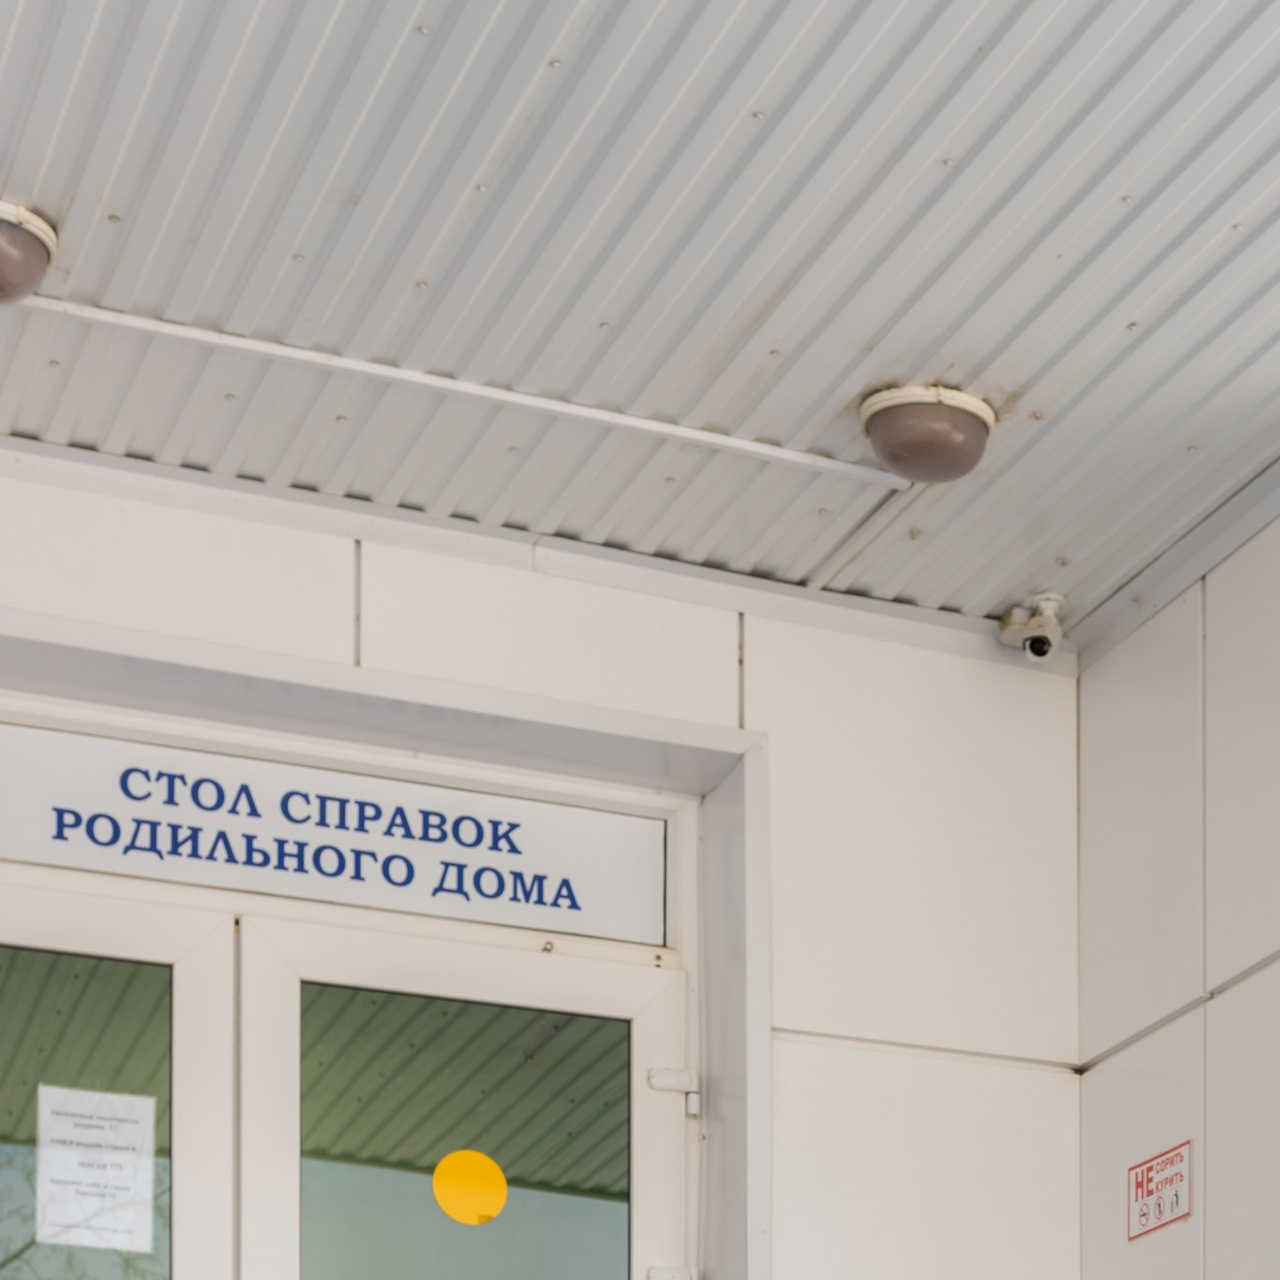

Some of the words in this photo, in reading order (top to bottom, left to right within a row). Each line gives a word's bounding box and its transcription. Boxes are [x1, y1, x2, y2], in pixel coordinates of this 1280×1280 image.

[119, 768, 261, 818] СТОЛ
[280, 791, 522, 855] СПРАВОК
[52, 808, 415, 888] РОДИЛЬНОГО
[432, 861, 581, 911] ДОМА
[1135, 1165, 1154, 1203] НЕ
